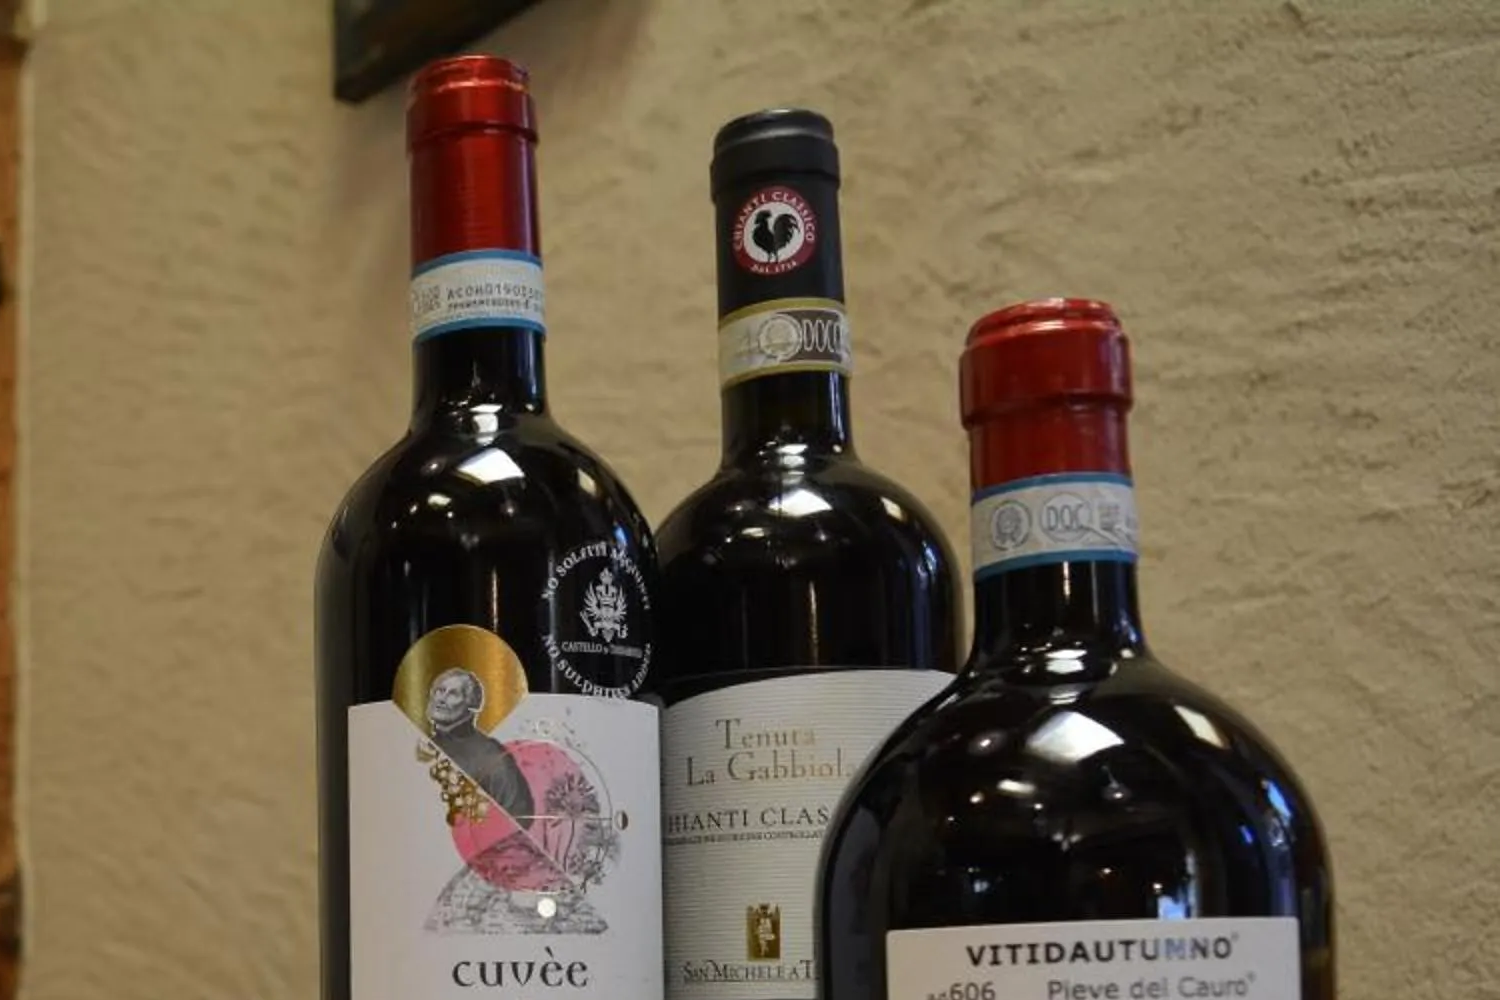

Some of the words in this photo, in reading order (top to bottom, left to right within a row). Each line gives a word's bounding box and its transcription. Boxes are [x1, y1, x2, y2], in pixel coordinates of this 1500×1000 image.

[733, 193, 767, 251] CHIANTI
[771, 191, 815, 243] CLASSICO
[560, 640, 603, 654] CASTELLO
[714, 717, 817, 751] Tenuta
[685, 755, 716, 787] La
[726, 747, 852, 782] Gabbiol
[667, 809, 749, 834] HIANTI
[760, 805, 829, 828] CLAS
[451, 945, 590, 988] cuvèe
[1129, 976, 1169, 1000] del
